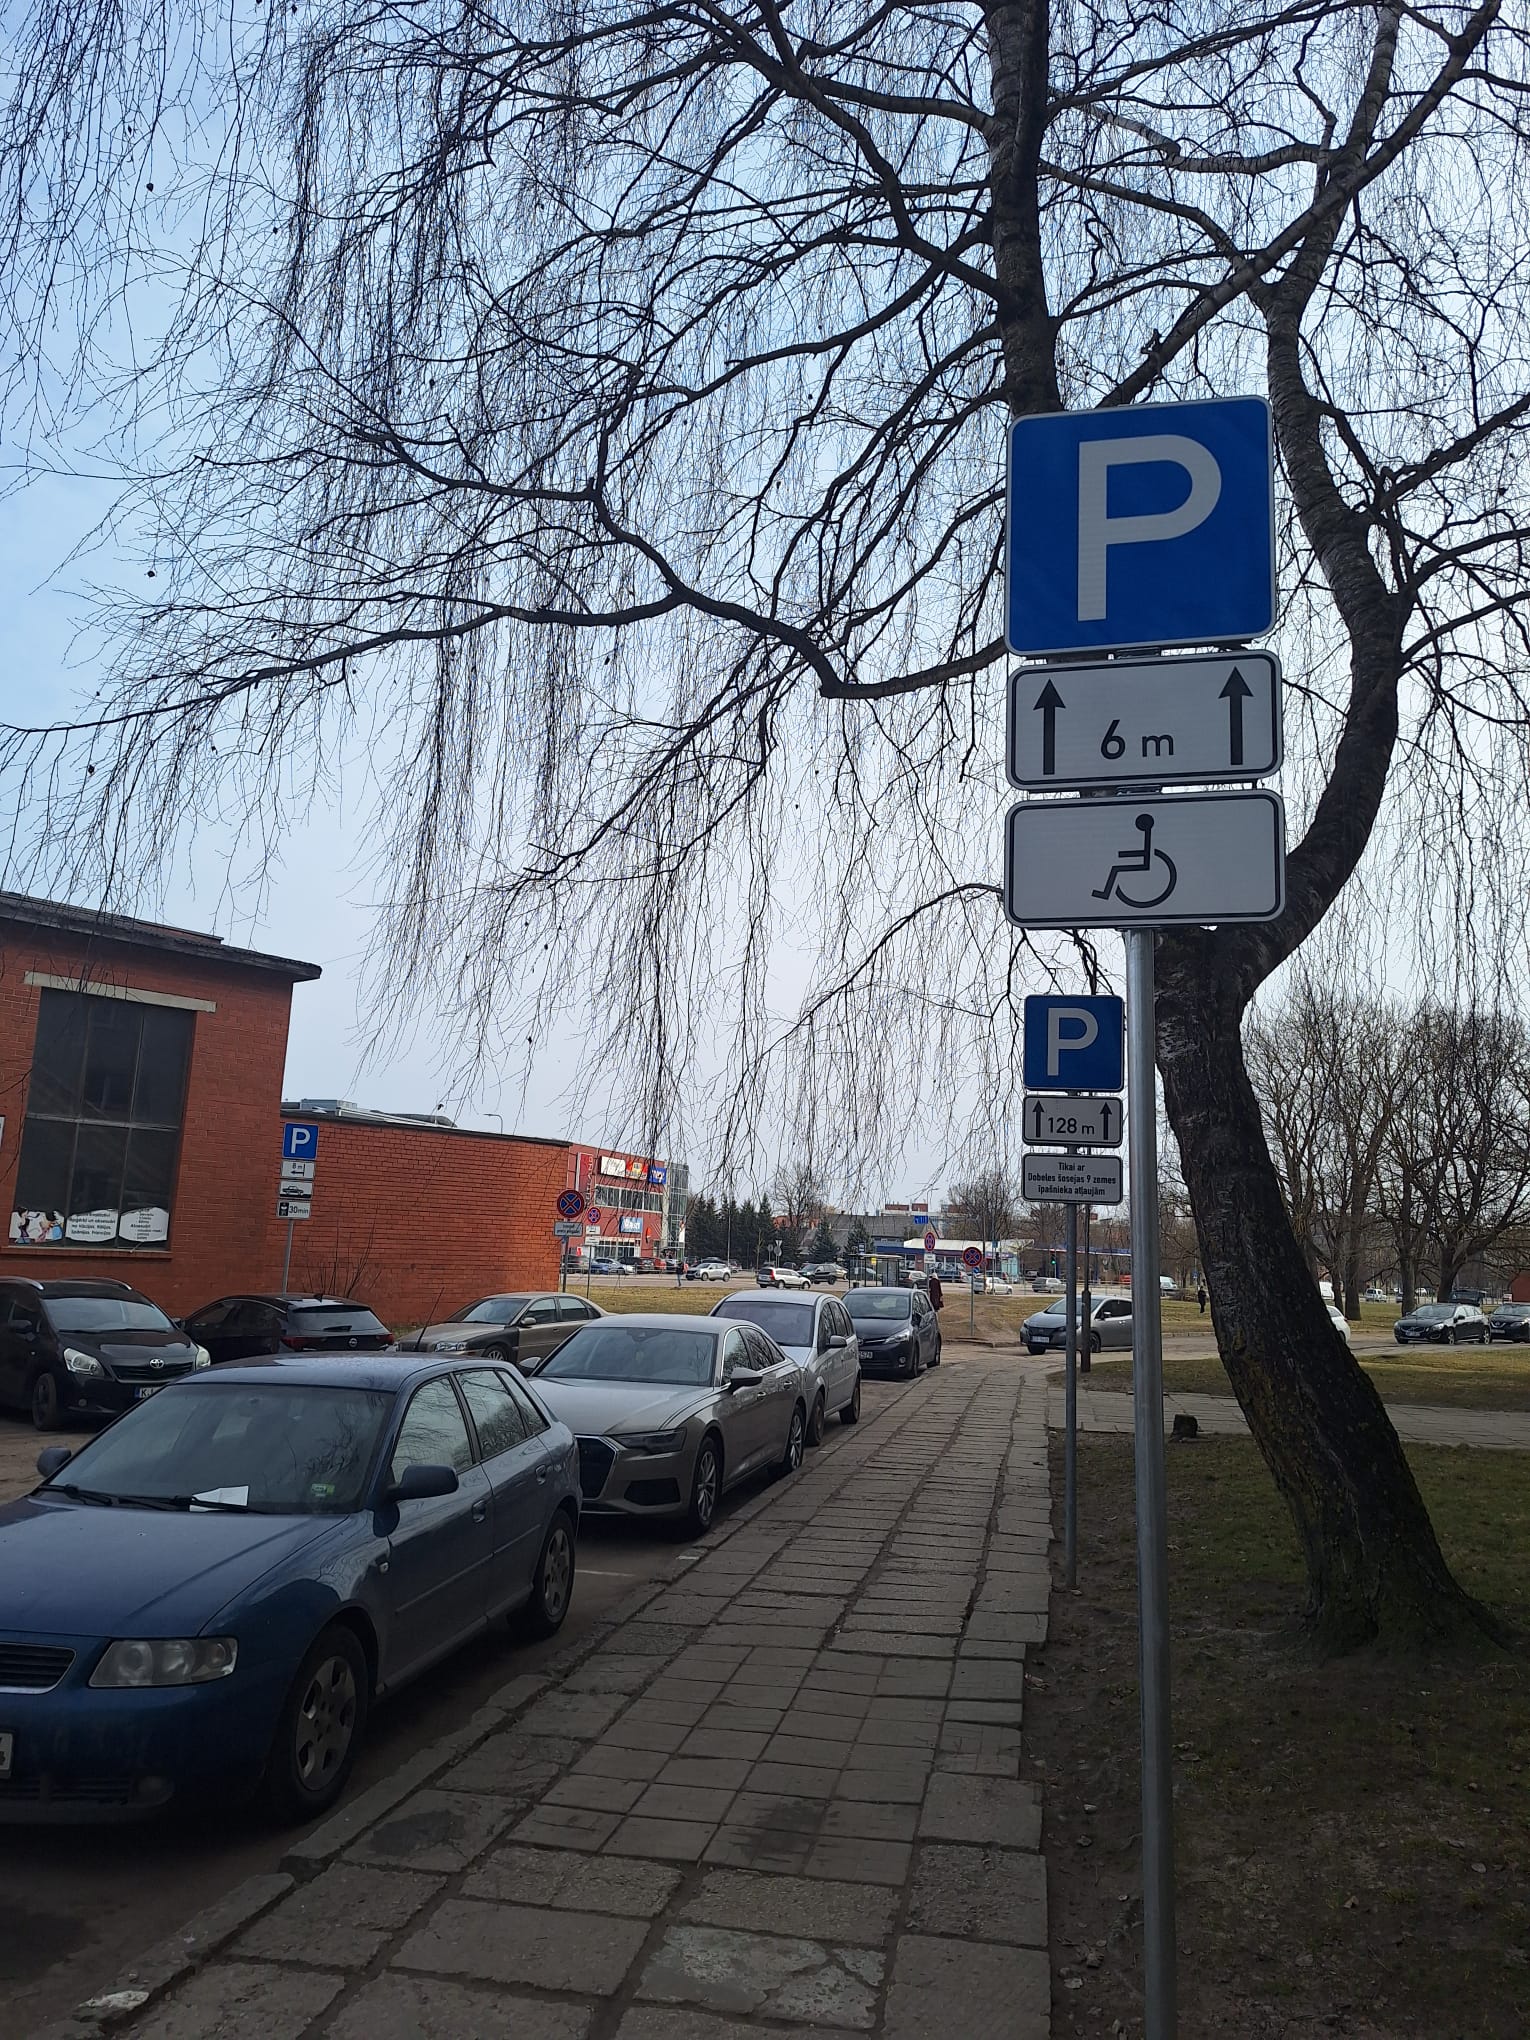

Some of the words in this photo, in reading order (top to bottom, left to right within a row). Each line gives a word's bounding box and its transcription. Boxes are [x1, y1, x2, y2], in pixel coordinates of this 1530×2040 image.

[1077, 433, 1222, 622] P
[1100, 719, 1126, 760] 6
[1142, 730, 1174, 757] m
[1047, 1007, 1099, 1076] P
[1048, 1118, 1077, 1134] 128
[1081, 1124, 1095, 1135] m
[290, 1128, 310, 1154] P
[1059, 1163, 1075, 1171] Tikai
[1028, 1173, 1055, 1182] Dobeles
[1058, 1174, 1085, 1184] šosejas
[1086, 1175, 1092, 1183] 9
[1038, 1184, 1073, 1194] īpašnieka
[1074, 1186, 1105, 1196] atļaujām
